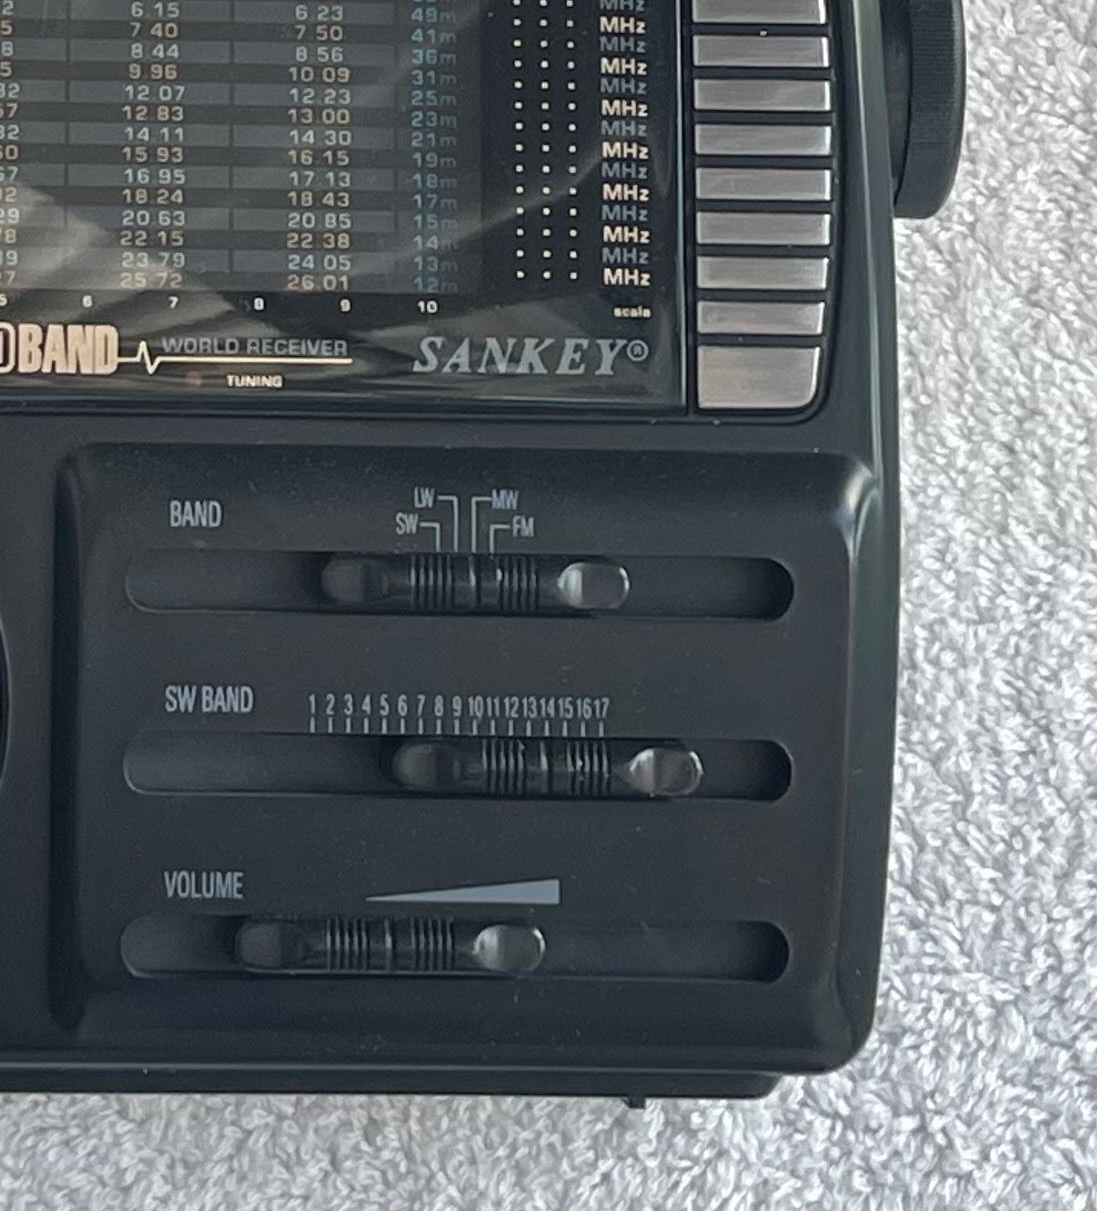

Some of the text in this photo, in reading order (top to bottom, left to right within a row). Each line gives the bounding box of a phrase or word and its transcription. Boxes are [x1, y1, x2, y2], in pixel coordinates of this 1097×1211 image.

[600, 16, 646, 34] MHz
[600, 37, 646, 53] MHz
[601, 58, 647, 75] MHz
[601, 78, 646, 94] MHz
[601, 100, 648, 117] MHz
[602, 121, 647, 137] MHz
[602, 142, 648, 159] MHz
[602, 163, 647, 179] MHz
[603, 184, 649, 201] MHz
[602, 205, 648, 221] MHz
[603, 226, 650, 244] MHz
[603, 247, 649, 264] MHz
[603, 268, 650, 286] MHz
[82, 295, 92, 308] 6
[169, 296, 178, 308] 7
[417, 300, 438, 313] 10
[162, 337, 238, 356] WORLD
[246, 338, 348, 356] RECEIVER
[226, 375, 283, 388] TUNING
[414, 488, 435, 508] LW
[492, 490, 519, 510] MW
[170, 500, 222, 528] BAND
[396, 513, 419, 535] SW
[513, 515, 535, 536] FM
[164, 686, 254, 714] SW BAND
[309, 693, 610, 719] 1 2 3 4 5 6 7 8 9 10 11 12 13 14 15 16 17
[164, 870, 244, 900] VOLUME
